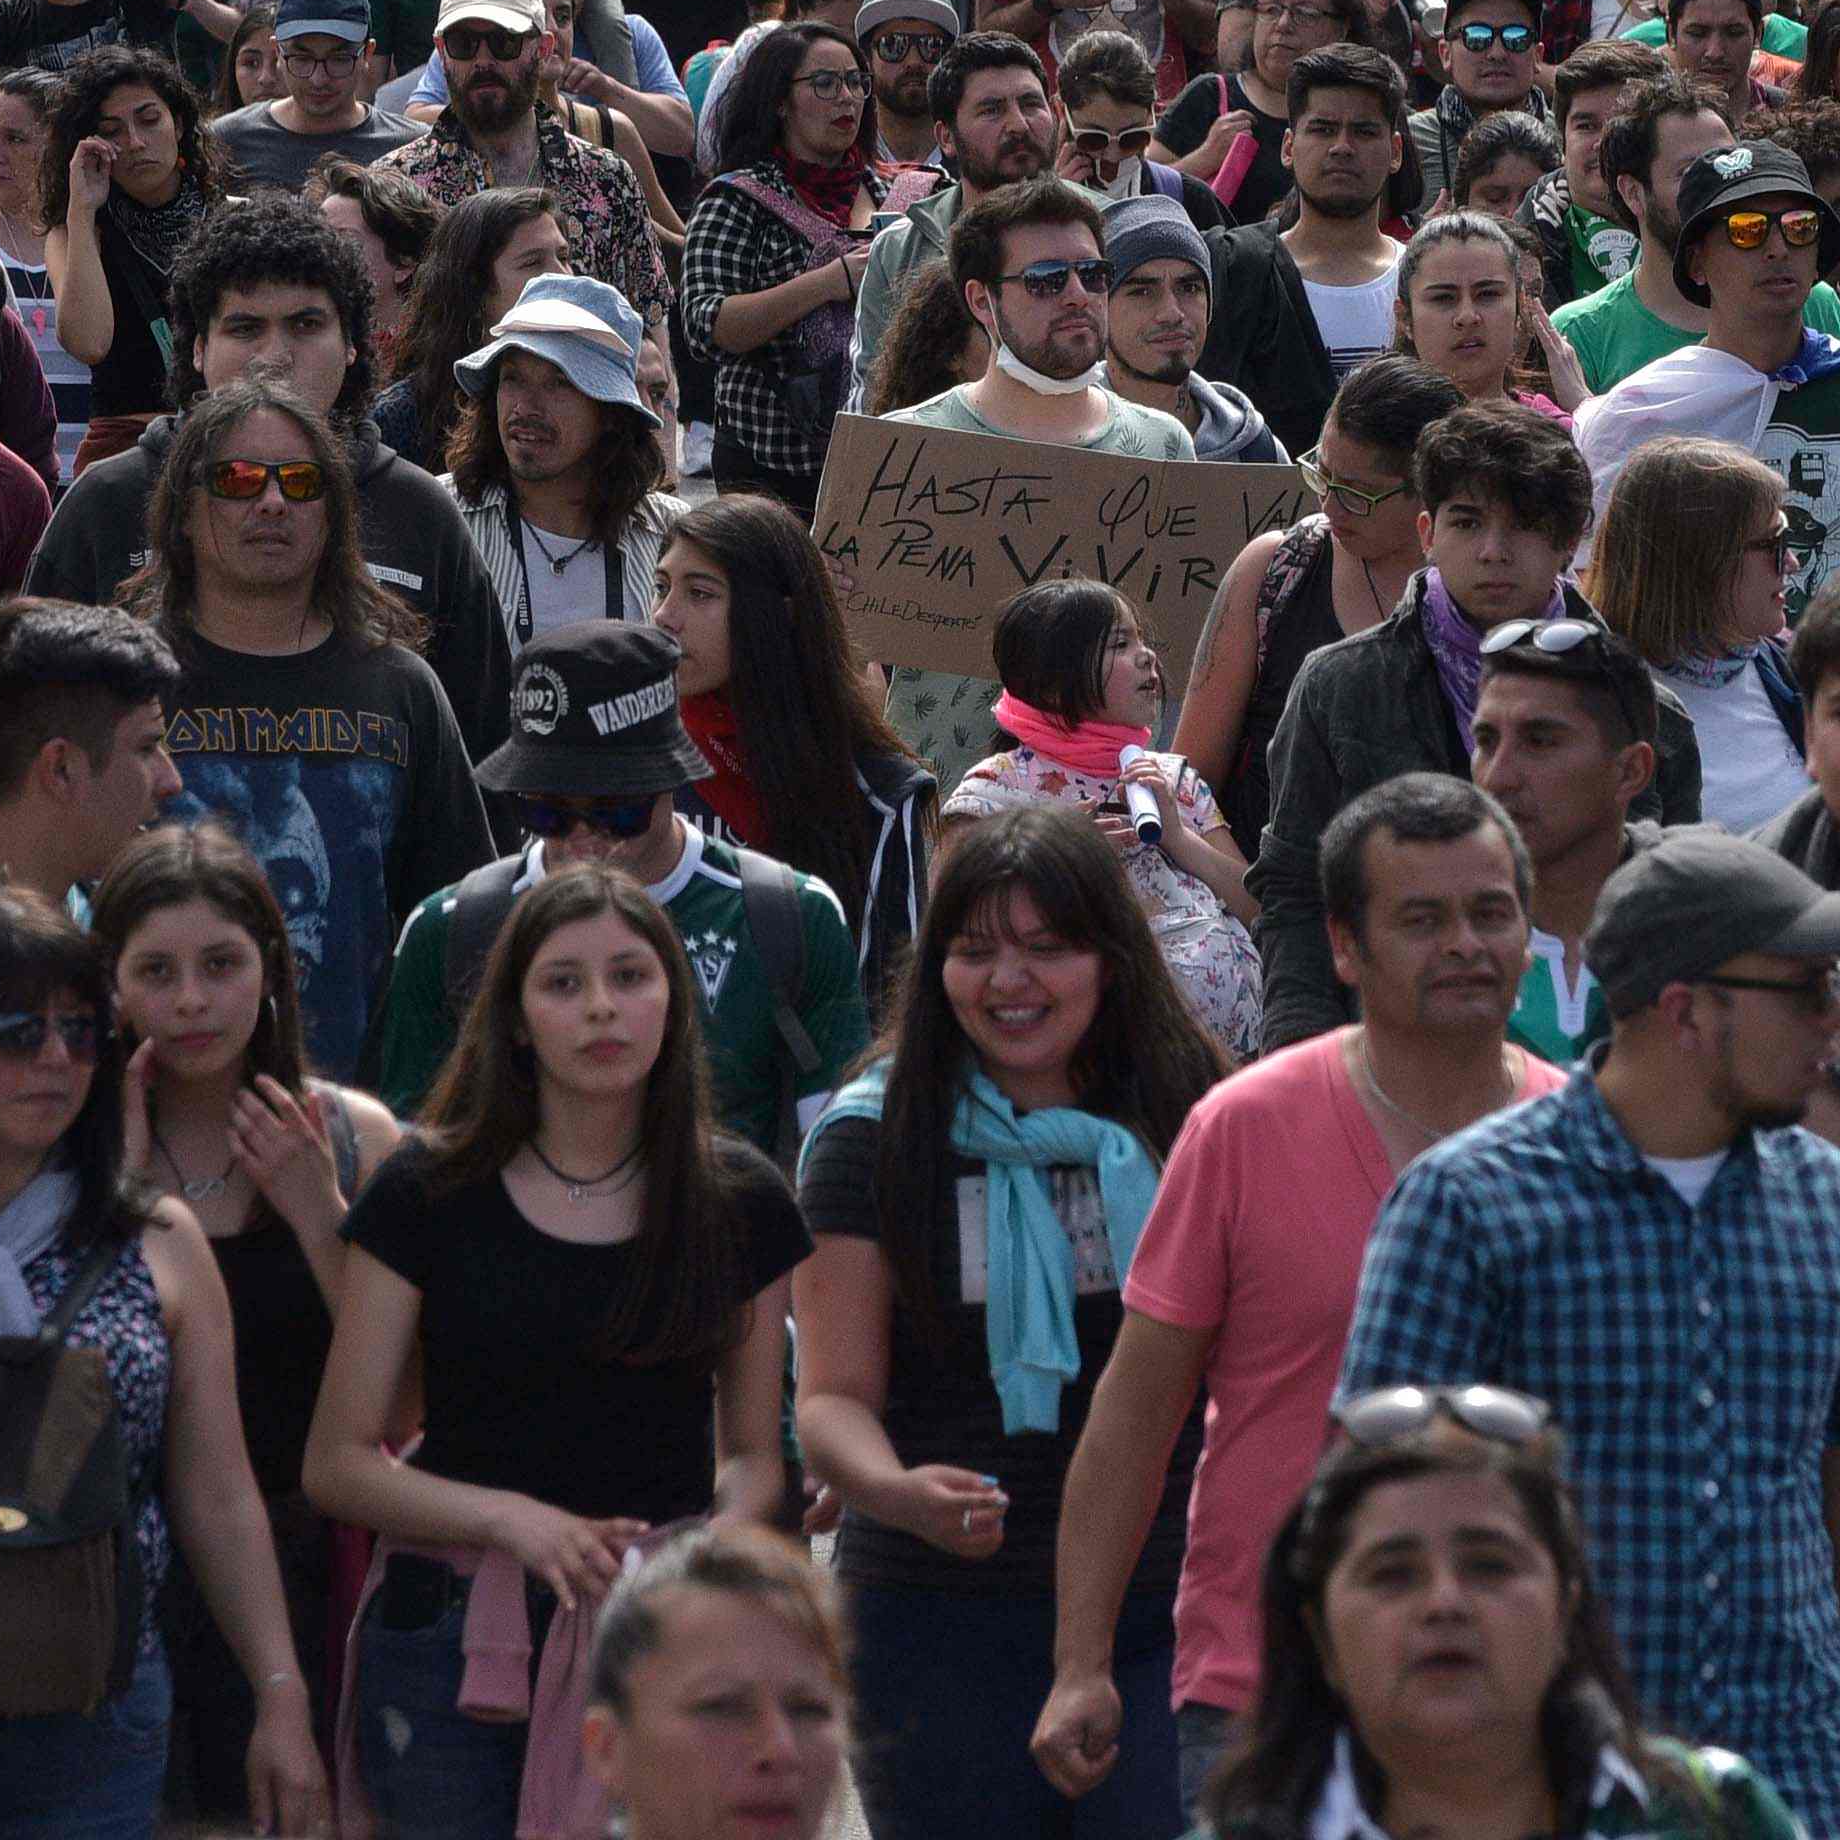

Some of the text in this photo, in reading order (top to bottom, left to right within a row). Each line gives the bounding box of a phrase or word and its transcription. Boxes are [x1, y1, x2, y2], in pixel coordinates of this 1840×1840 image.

[858, 438, 1053, 528] HASTA
[819, 521, 860, 566] LA
[876, 518, 977, 588] PENA
[520, 687, 555, 714] 1892
[238, 706, 409, 769] MAIDEN
